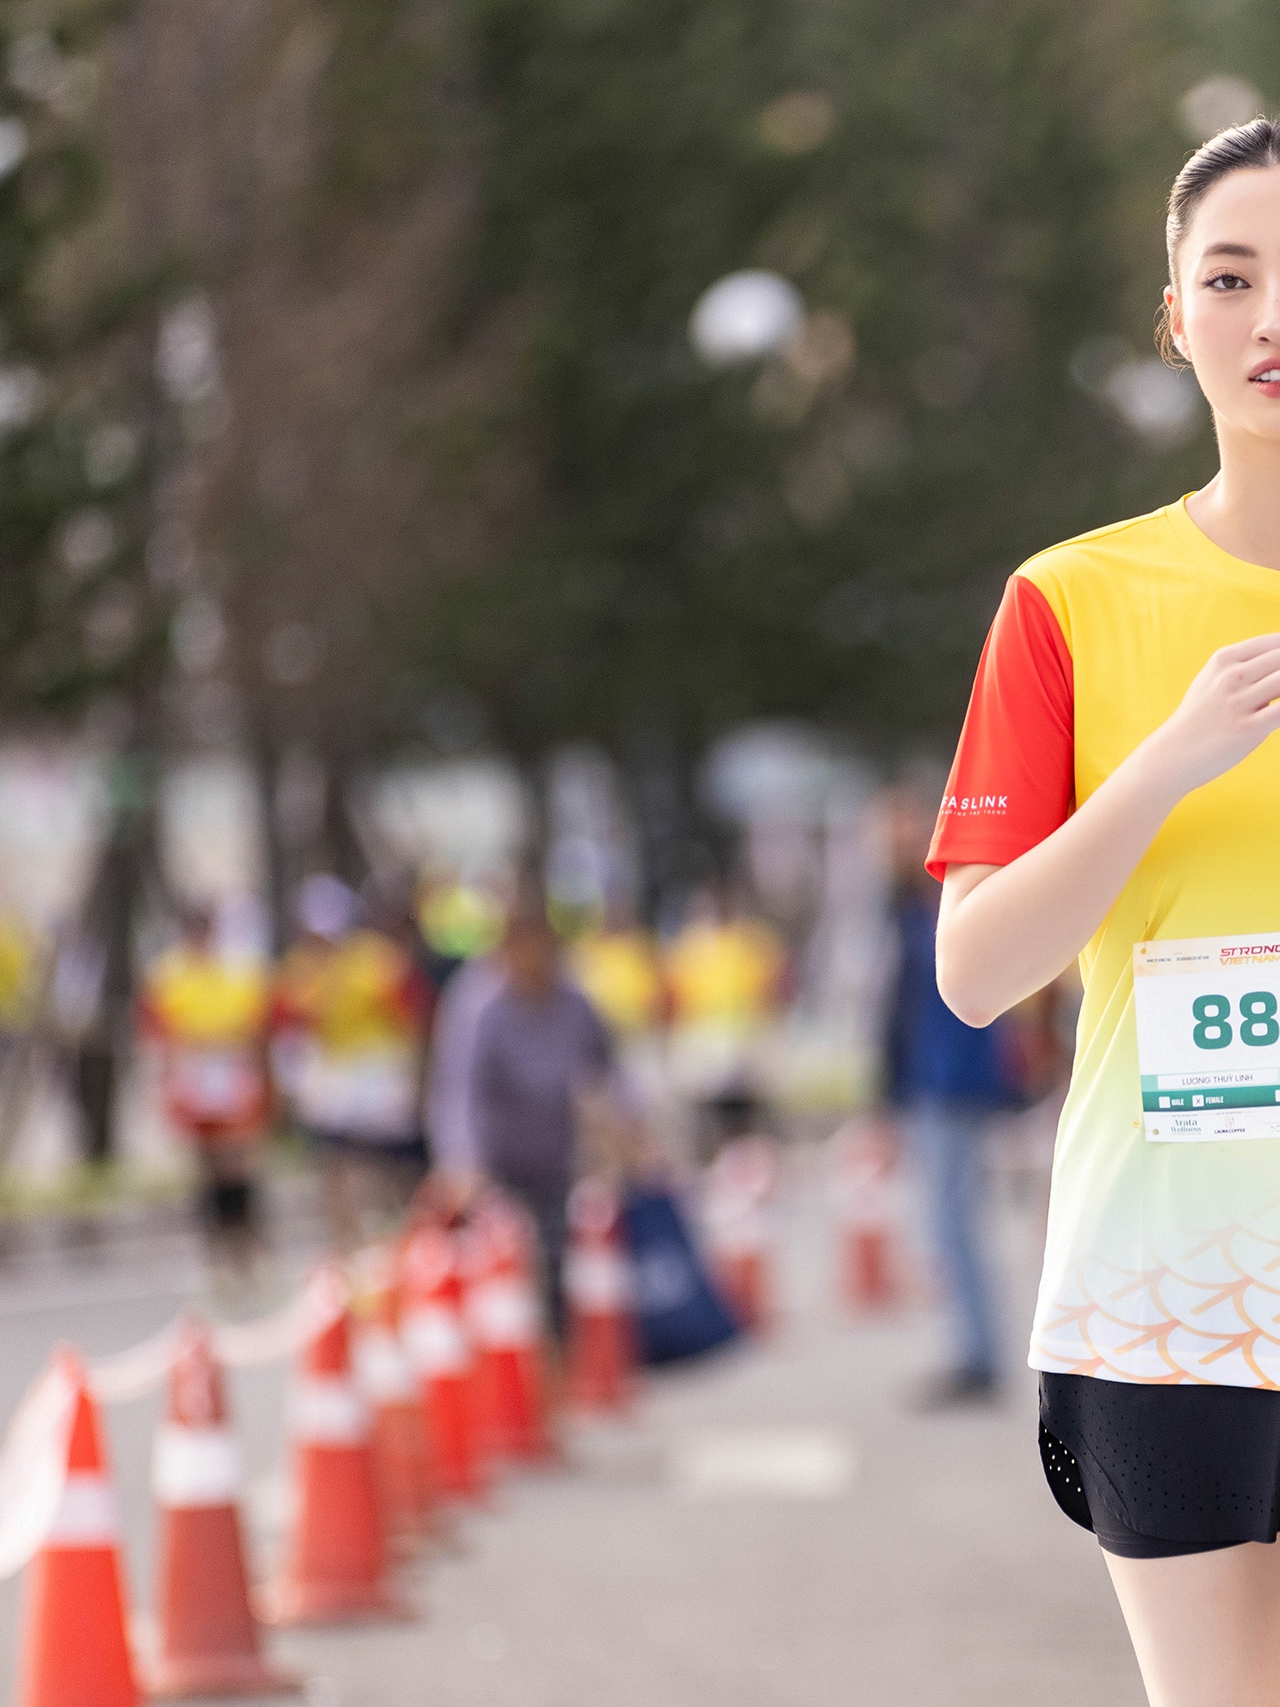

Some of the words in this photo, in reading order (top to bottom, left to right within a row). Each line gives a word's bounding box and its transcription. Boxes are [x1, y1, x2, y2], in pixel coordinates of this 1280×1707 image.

[1235, 1074, 1254, 1083] LINH
[1171, 1098, 1185, 1106] MALE
[1205, 1096, 1224, 1104] FEMALE
